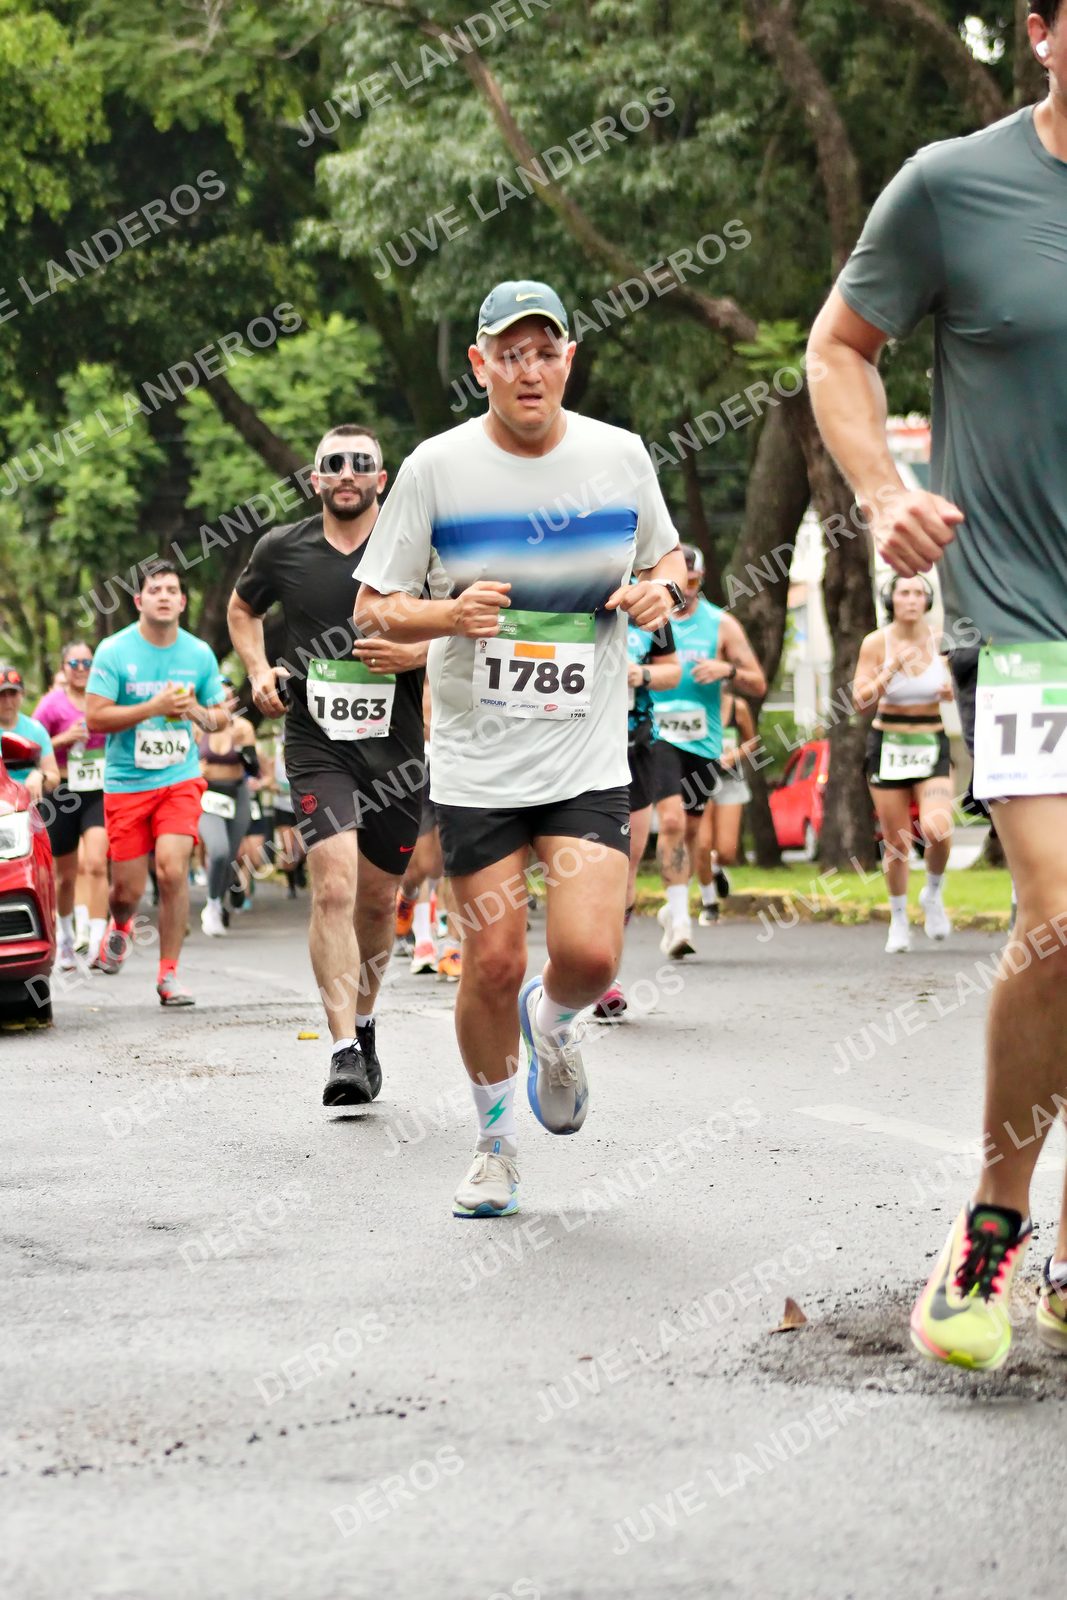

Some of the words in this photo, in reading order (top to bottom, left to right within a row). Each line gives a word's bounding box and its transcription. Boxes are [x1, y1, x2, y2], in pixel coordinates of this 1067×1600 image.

[485, 657, 586, 694] 1786
[314, 696, 387, 721] 1863
[140, 740, 187, 756] 4304
[994, 711, 1067, 756] 17
